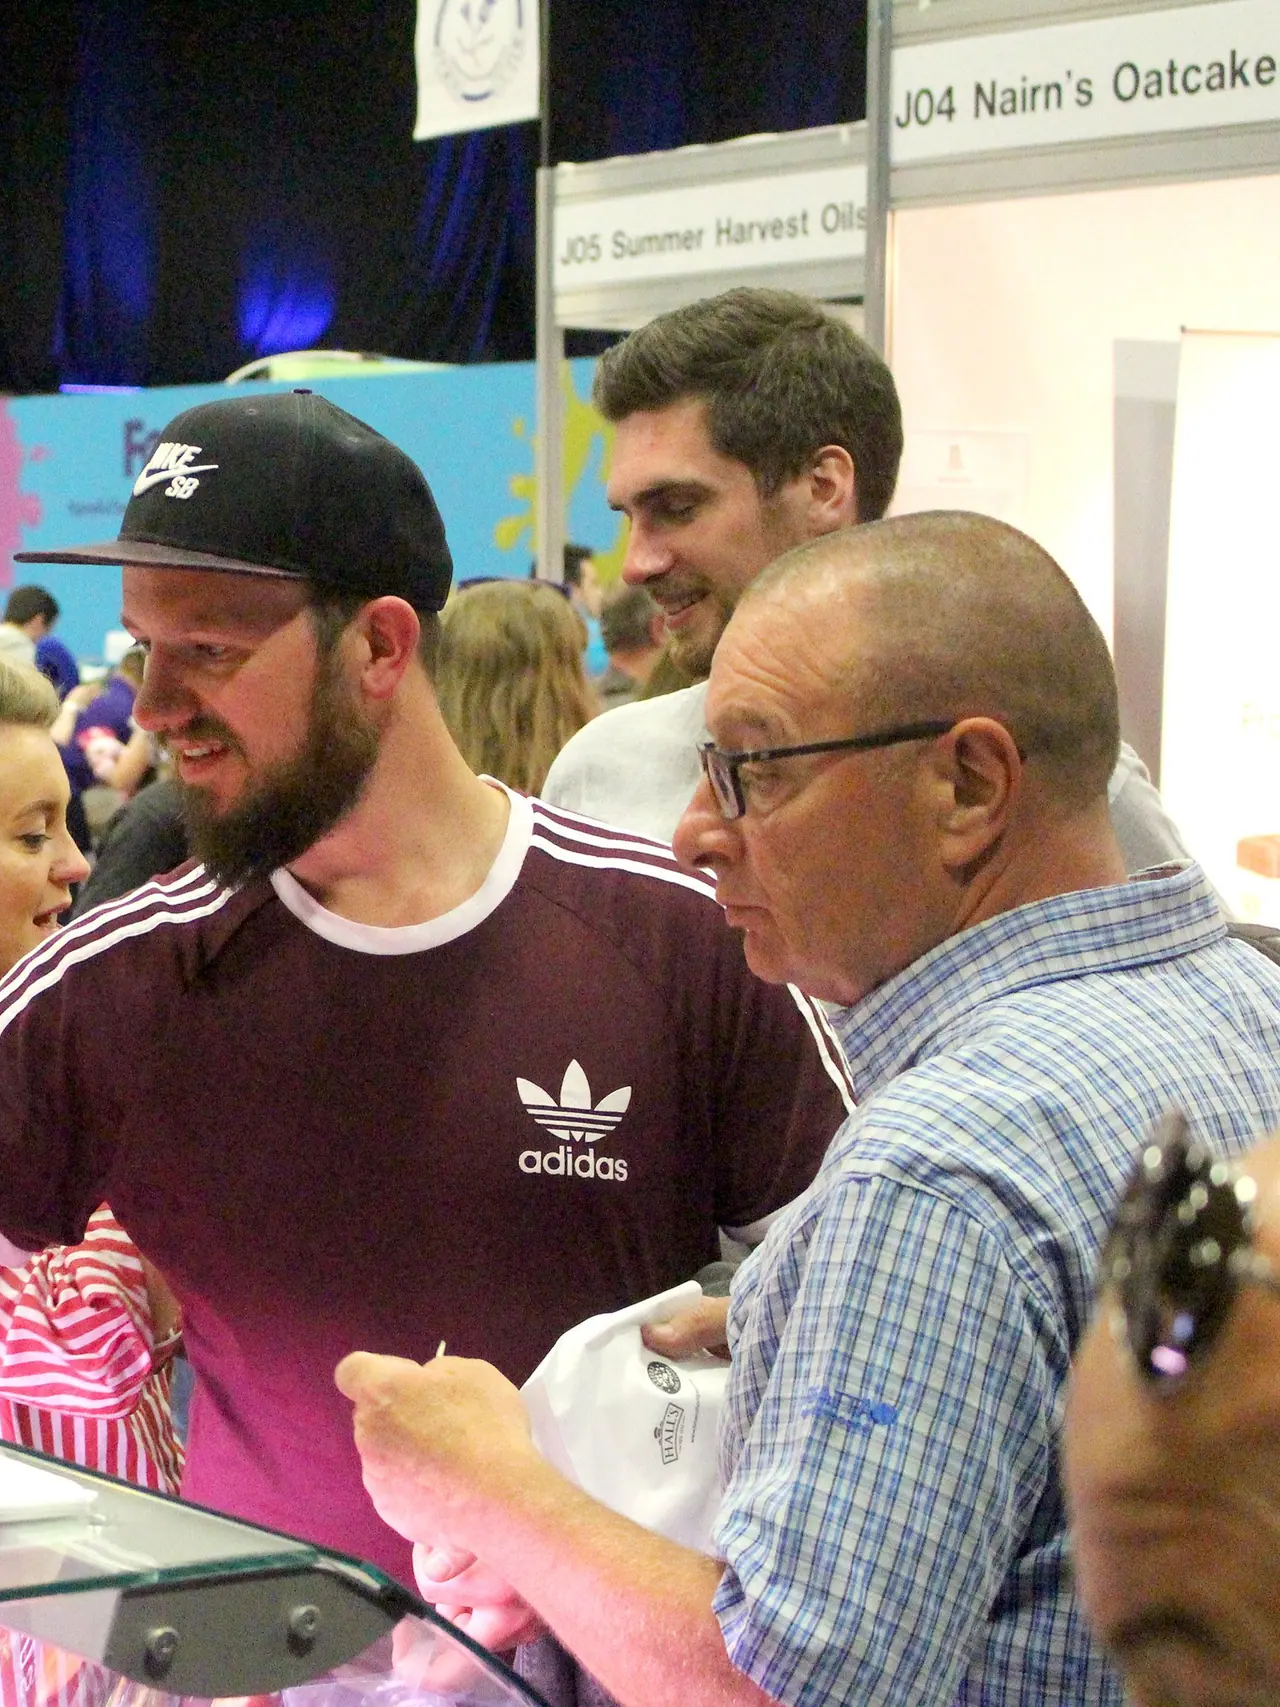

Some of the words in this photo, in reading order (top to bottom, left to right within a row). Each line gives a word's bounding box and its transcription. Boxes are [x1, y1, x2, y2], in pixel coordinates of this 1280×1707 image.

[895, 86, 956, 128] J04
[973, 70, 1093, 119] Nairn's
[1112, 49, 1277, 102] Oatcake
[561, 233, 602, 266] J05
[611, 226, 705, 260] Summer
[715, 208, 809, 246] Harvest
[820, 202, 867, 235] Oils
[149, 442, 202, 470] NIKE
[164, 475, 200, 499] SB
[518, 1145, 629, 1182] adidas
